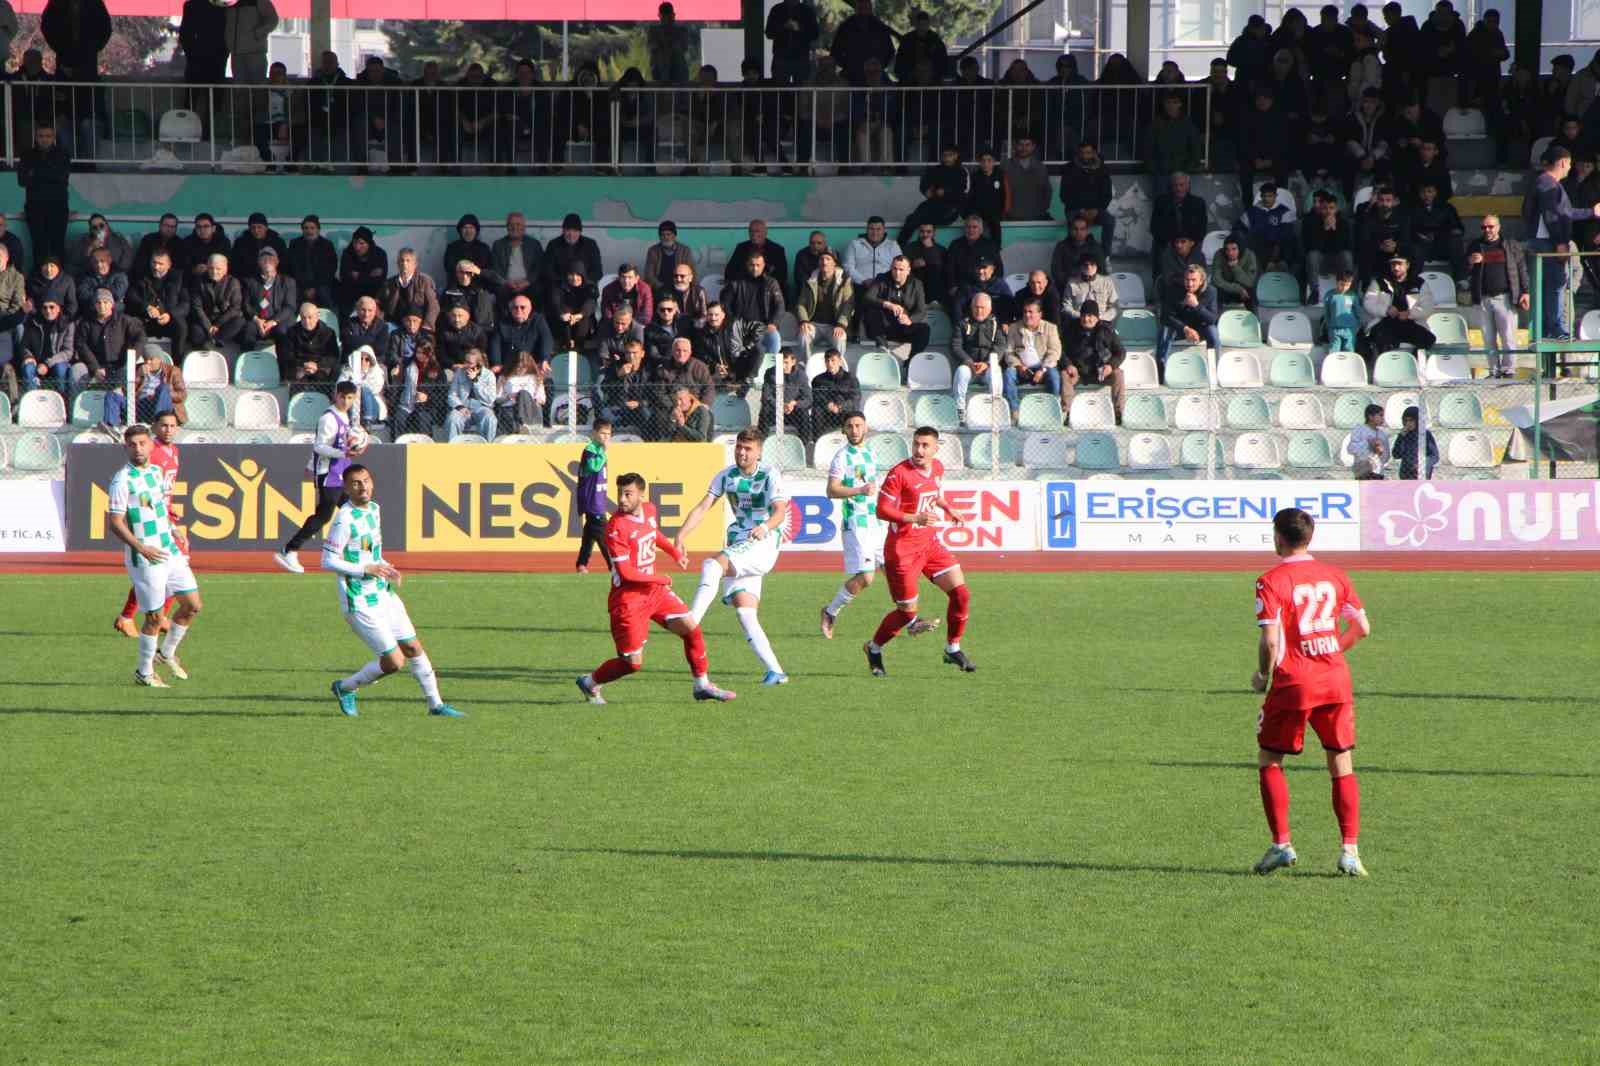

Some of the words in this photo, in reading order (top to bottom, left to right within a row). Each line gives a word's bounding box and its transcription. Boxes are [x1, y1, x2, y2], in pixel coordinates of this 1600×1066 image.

[1128, 533, 1273, 544] MARKE
[1456, 481, 1600, 541] nur
[1293, 580, 1337, 635] 22
